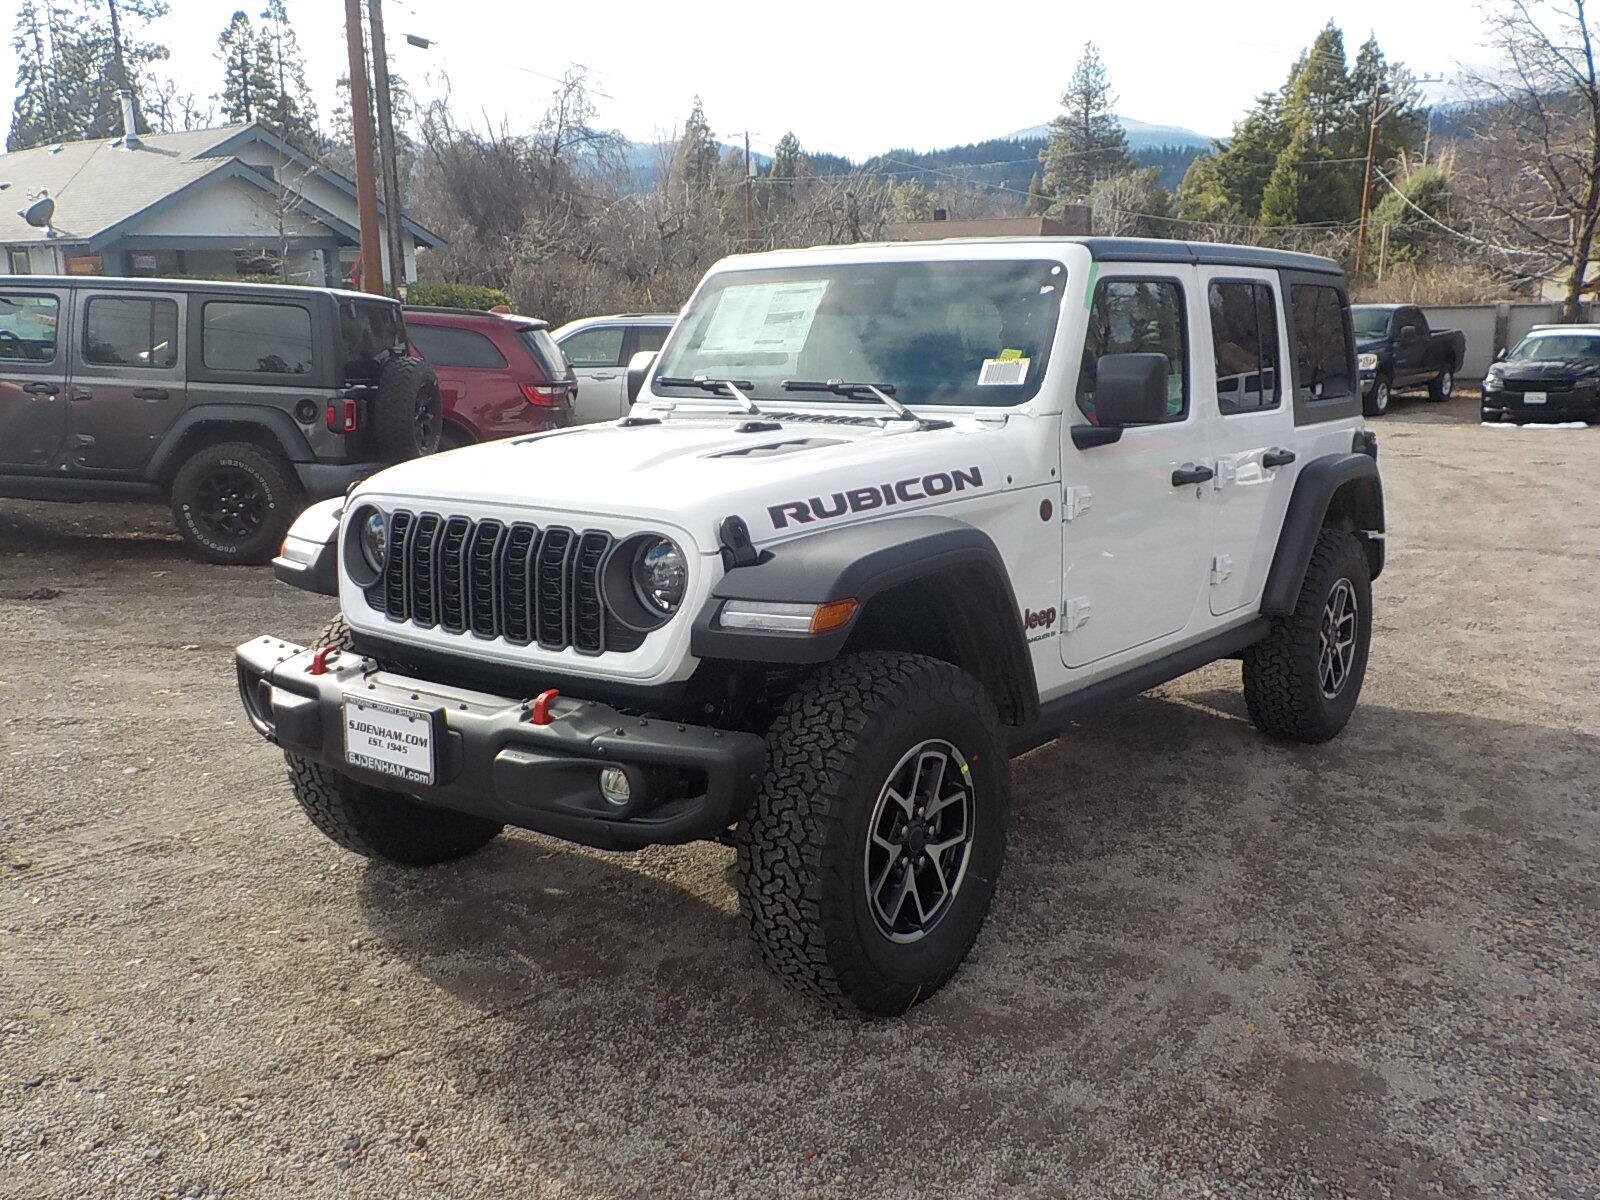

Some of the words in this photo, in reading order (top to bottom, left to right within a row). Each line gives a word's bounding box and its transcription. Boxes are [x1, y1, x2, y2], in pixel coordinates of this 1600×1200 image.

[767, 466, 983, 529] RUBICON
[1024, 606, 1056, 629] Jeep
[1026, 632, 1050, 643] ANGLER
[349, 720, 428, 747] SJDENHAM.COM
[368, 737, 384, 747] EST.
[387, 742, 408, 754] 1945
[348, 752, 429, 784] SJDENHAM.com
